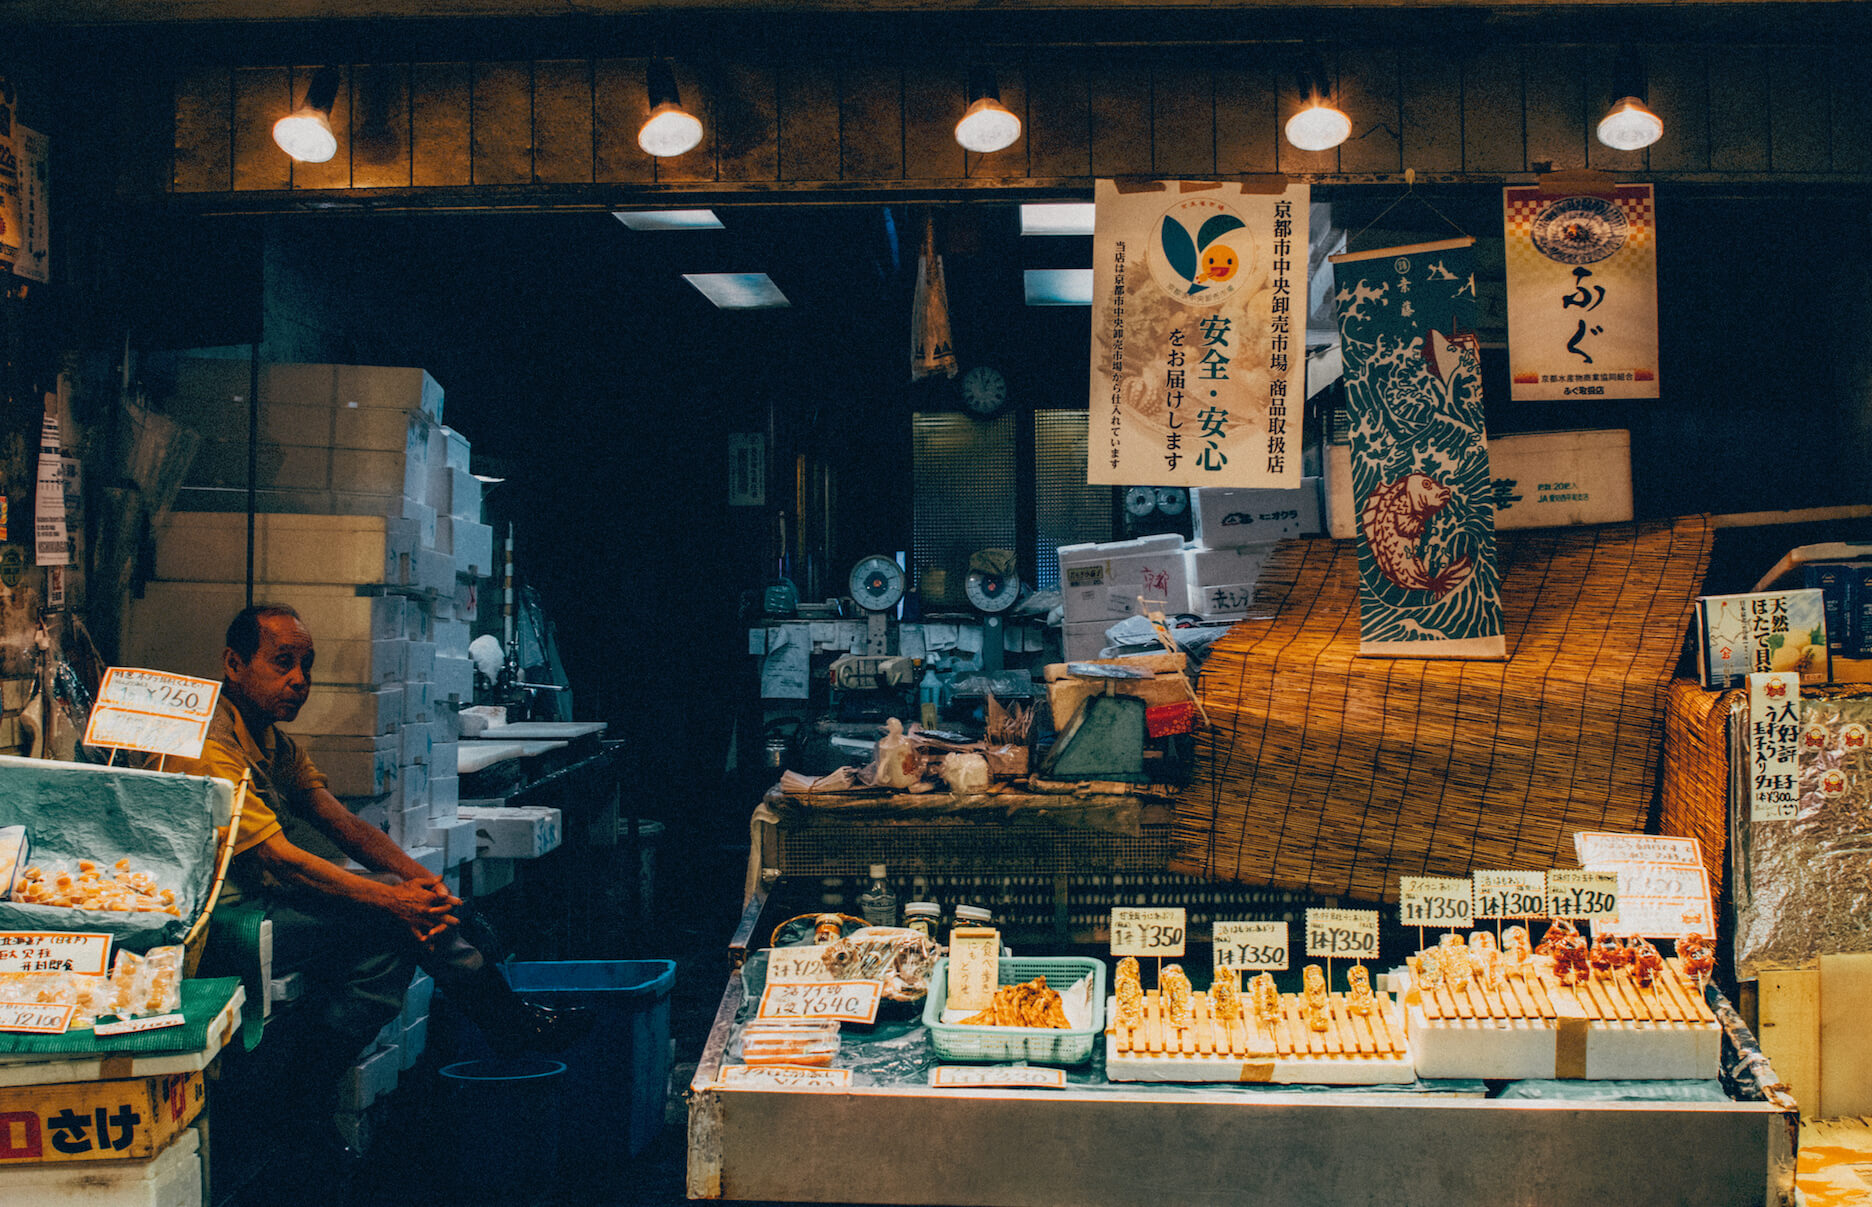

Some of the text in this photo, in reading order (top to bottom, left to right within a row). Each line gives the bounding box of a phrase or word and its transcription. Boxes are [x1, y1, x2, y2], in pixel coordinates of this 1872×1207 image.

[1267, 200, 1292, 474] 京都市中央卸売市場 商品取扱店
[1562, 266, 1606, 364] ふぐ
[1109, 241, 1126, 470] 当店は京都市中央卸売市場から仕入れています
[1195, 315, 1232, 472] 安全・安心
[1164, 329, 1187, 472] をお届けします
[1259, 510, 1298, 520] ミニオクラ
[1769, 596, 1790, 633] 天然
[1765, 705, 1779, 759] うずら
[1778, 701, 1799, 763] 大好評
[47, 1104, 141, 1154] さけ
